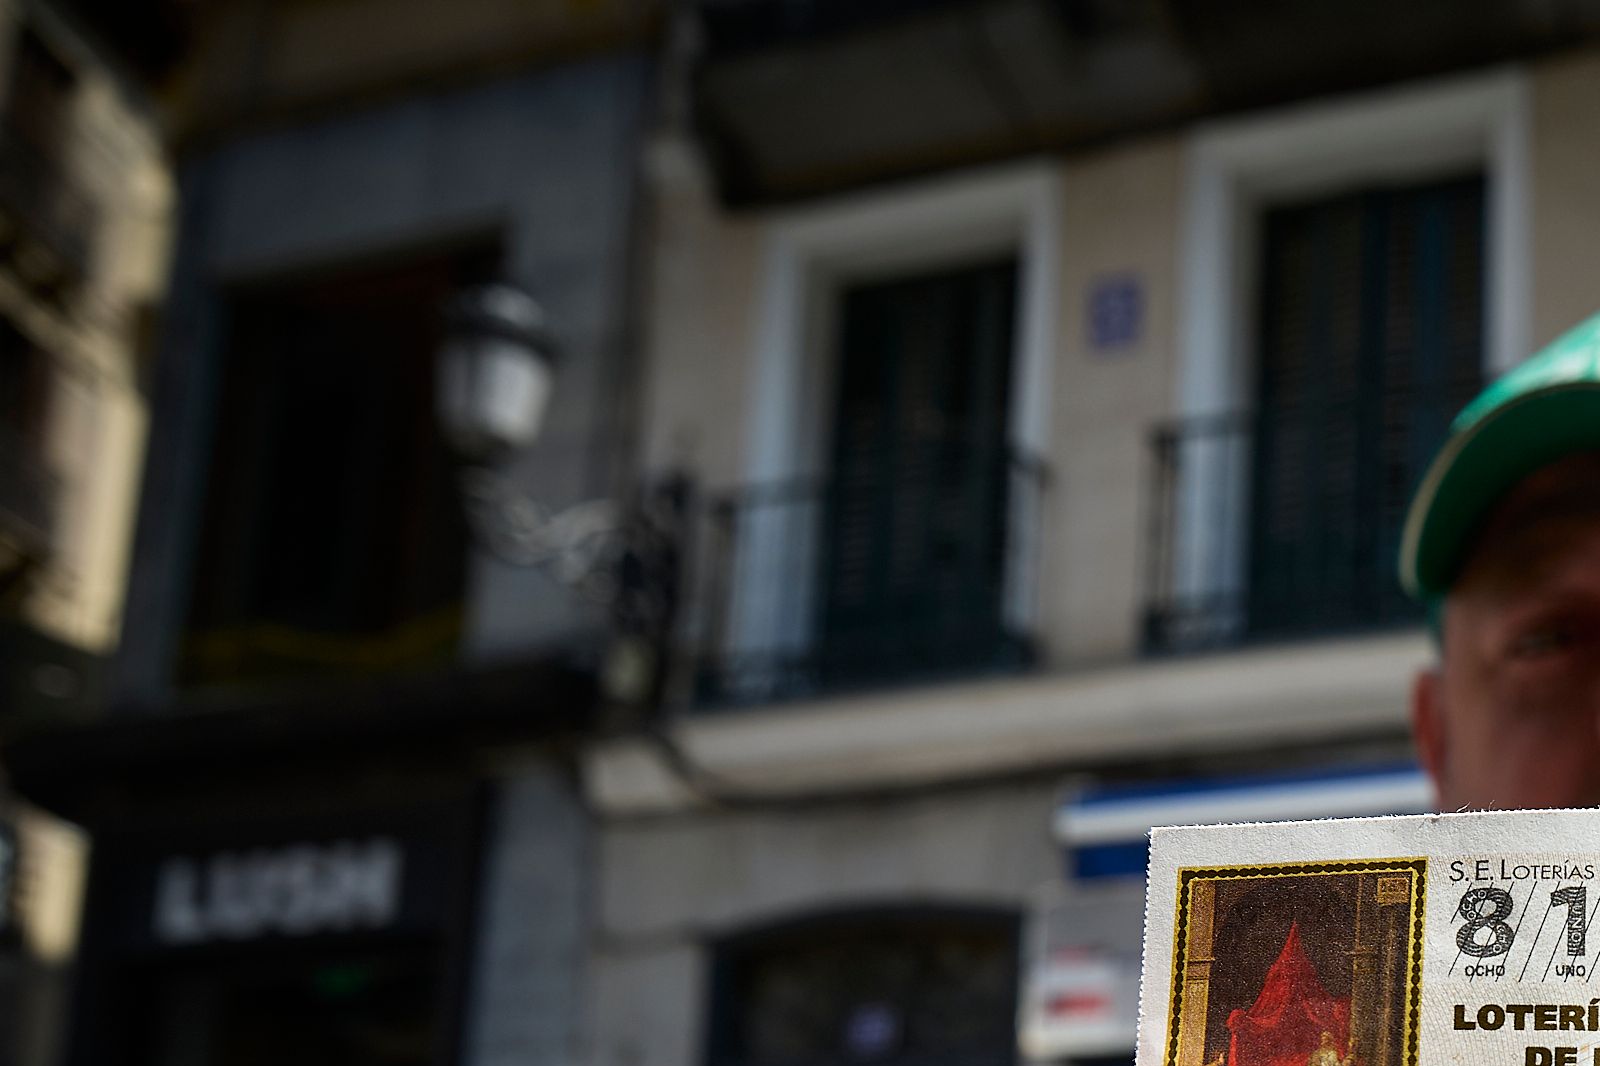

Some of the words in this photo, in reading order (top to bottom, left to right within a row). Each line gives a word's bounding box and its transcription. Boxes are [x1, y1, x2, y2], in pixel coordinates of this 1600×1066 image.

[157, 838, 402, 942] LUSH
[1465, 965, 1505, 977] OCHO
[1556, 965, 1586, 977] UNO
